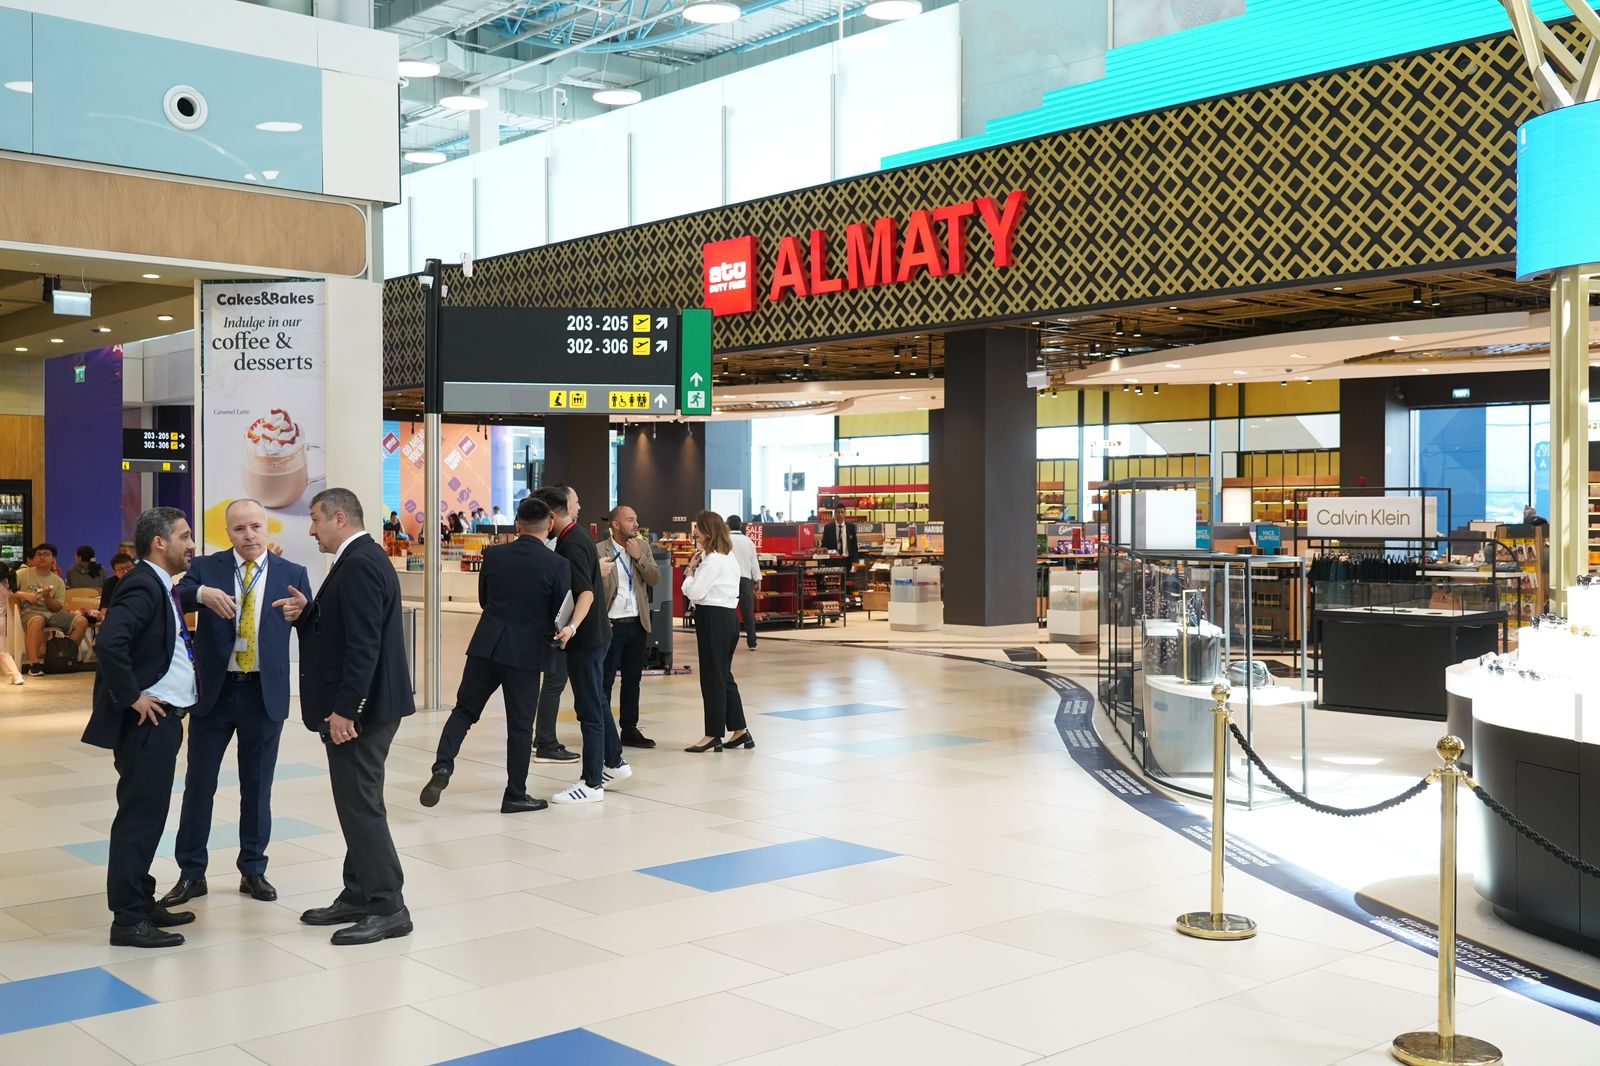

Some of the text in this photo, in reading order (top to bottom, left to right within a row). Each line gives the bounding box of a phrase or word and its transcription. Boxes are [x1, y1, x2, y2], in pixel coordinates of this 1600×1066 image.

[769, 190, 1028, 300] ALMATY
[709, 280, 747, 293] DUTY FREE
[216, 291, 315, 306] Cakes&Bakes
[224, 316, 302, 331] Indulge in our
[566, 315, 593, 331] 203
[602, 315, 629, 331] 205
[212, 331, 293, 350] coffee &
[566, 338, 593, 354] 302
[602, 338, 628, 354] 306
[233, 352, 313, 371] desserts
[158, 432, 169, 440] 205
[143, 441, 155, 449] 302
[158, 441, 169, 449] 306
[1317, 509, 1410, 526] Calvin Klein
[746, 525, 762, 534] SALE
